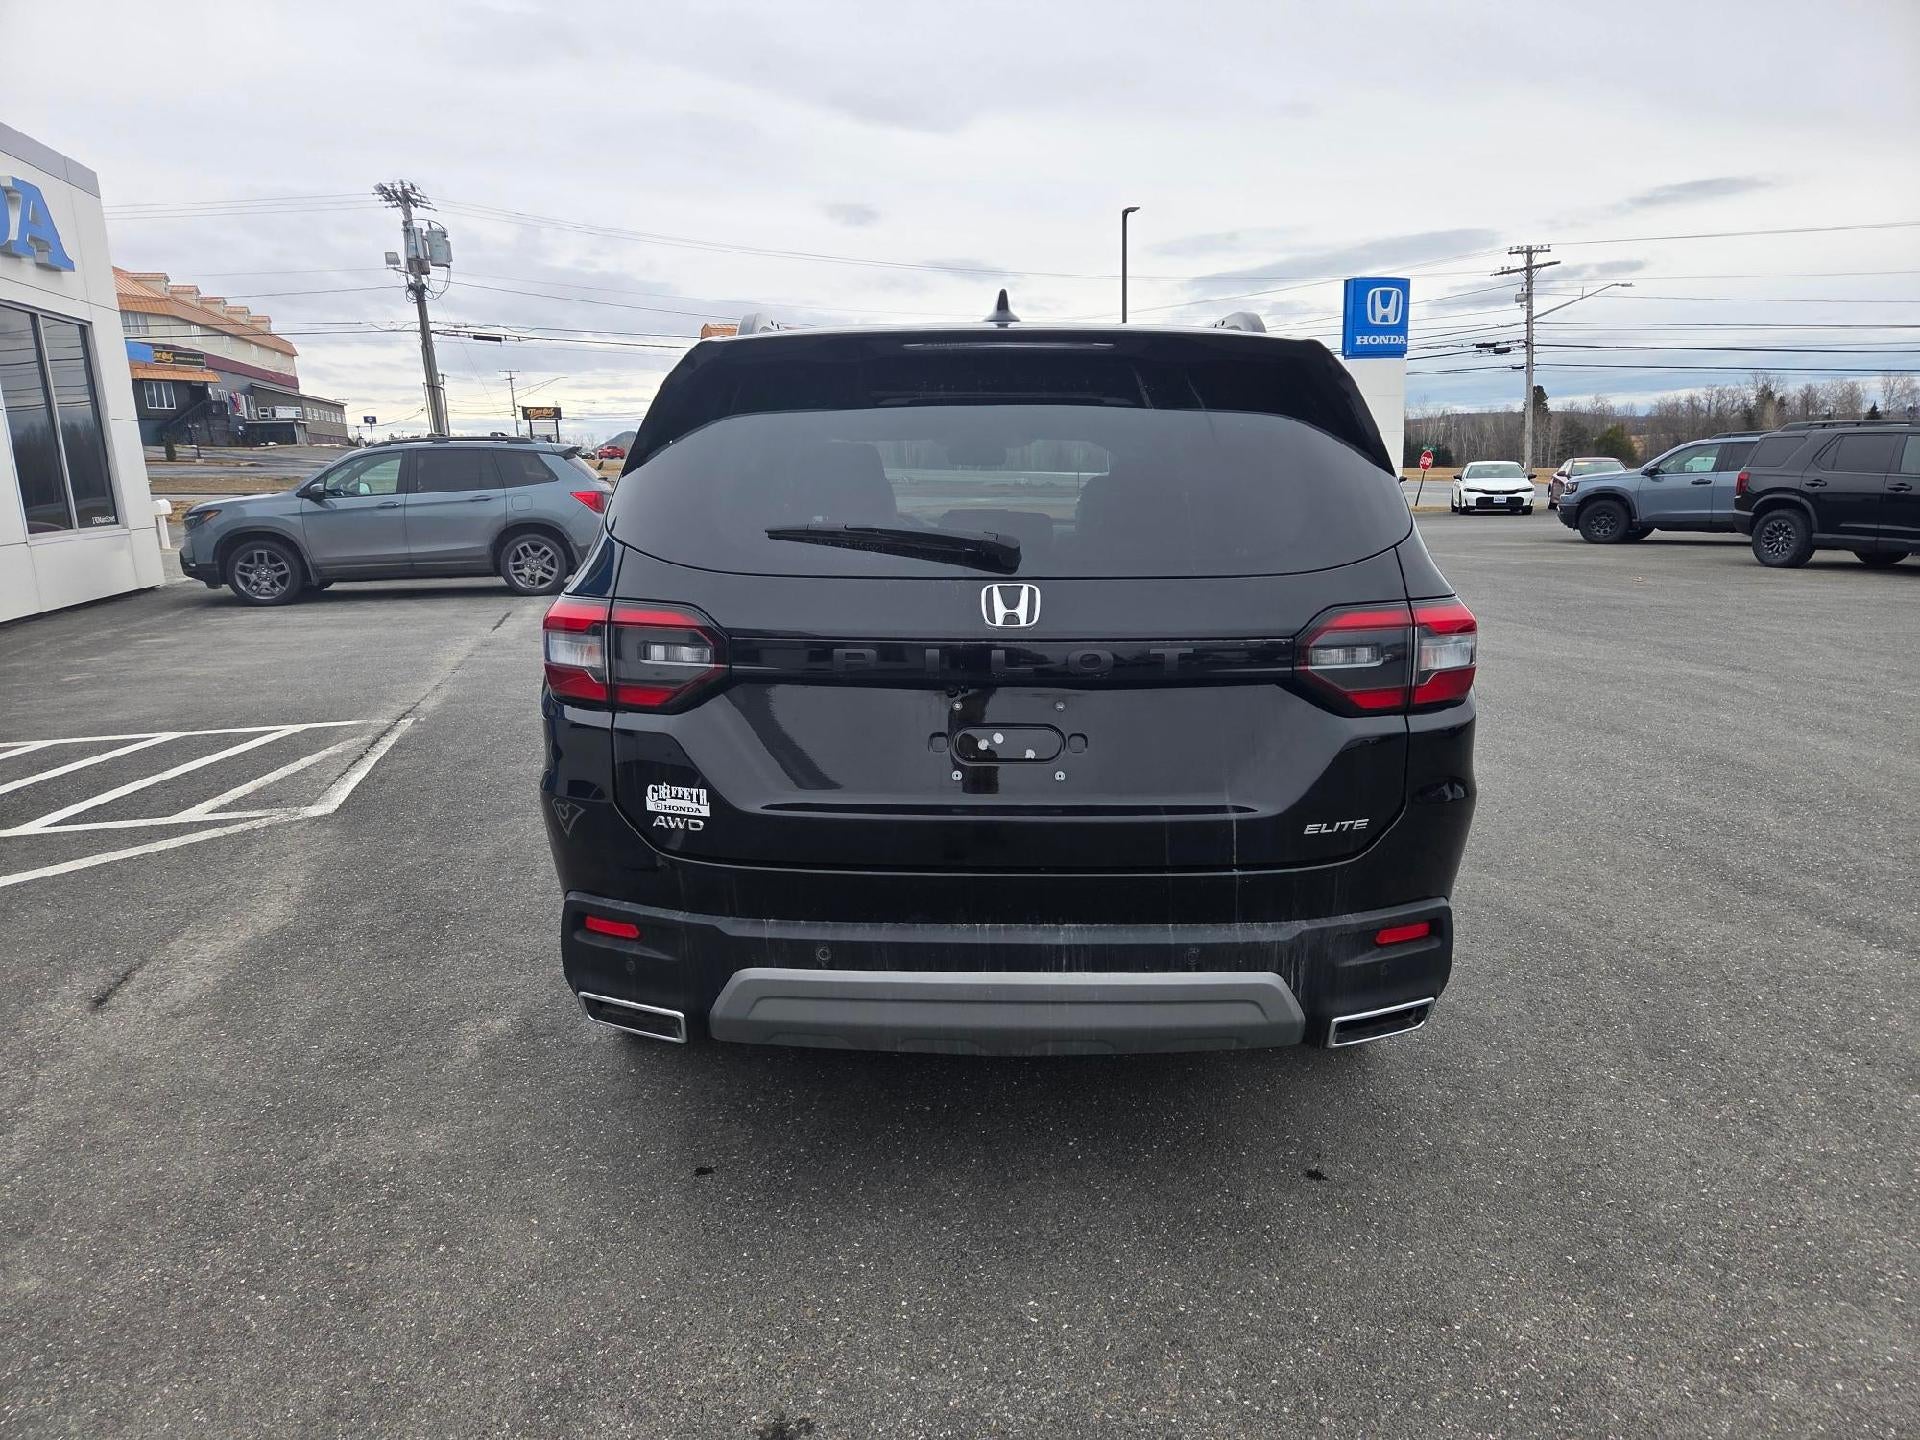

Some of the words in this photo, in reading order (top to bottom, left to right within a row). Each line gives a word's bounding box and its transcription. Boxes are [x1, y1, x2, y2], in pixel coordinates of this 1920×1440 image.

[1355, 335, 1407, 345] HONDA
[1420, 456, 1432, 466] STOP
[833, 648, 1194, 675] PILOT
[647, 783, 707, 806] GRIFFETH
[664, 805, 702, 814] HONDA
[652, 815, 704, 831] AWD
[1304, 818, 1370, 835] ELITE
